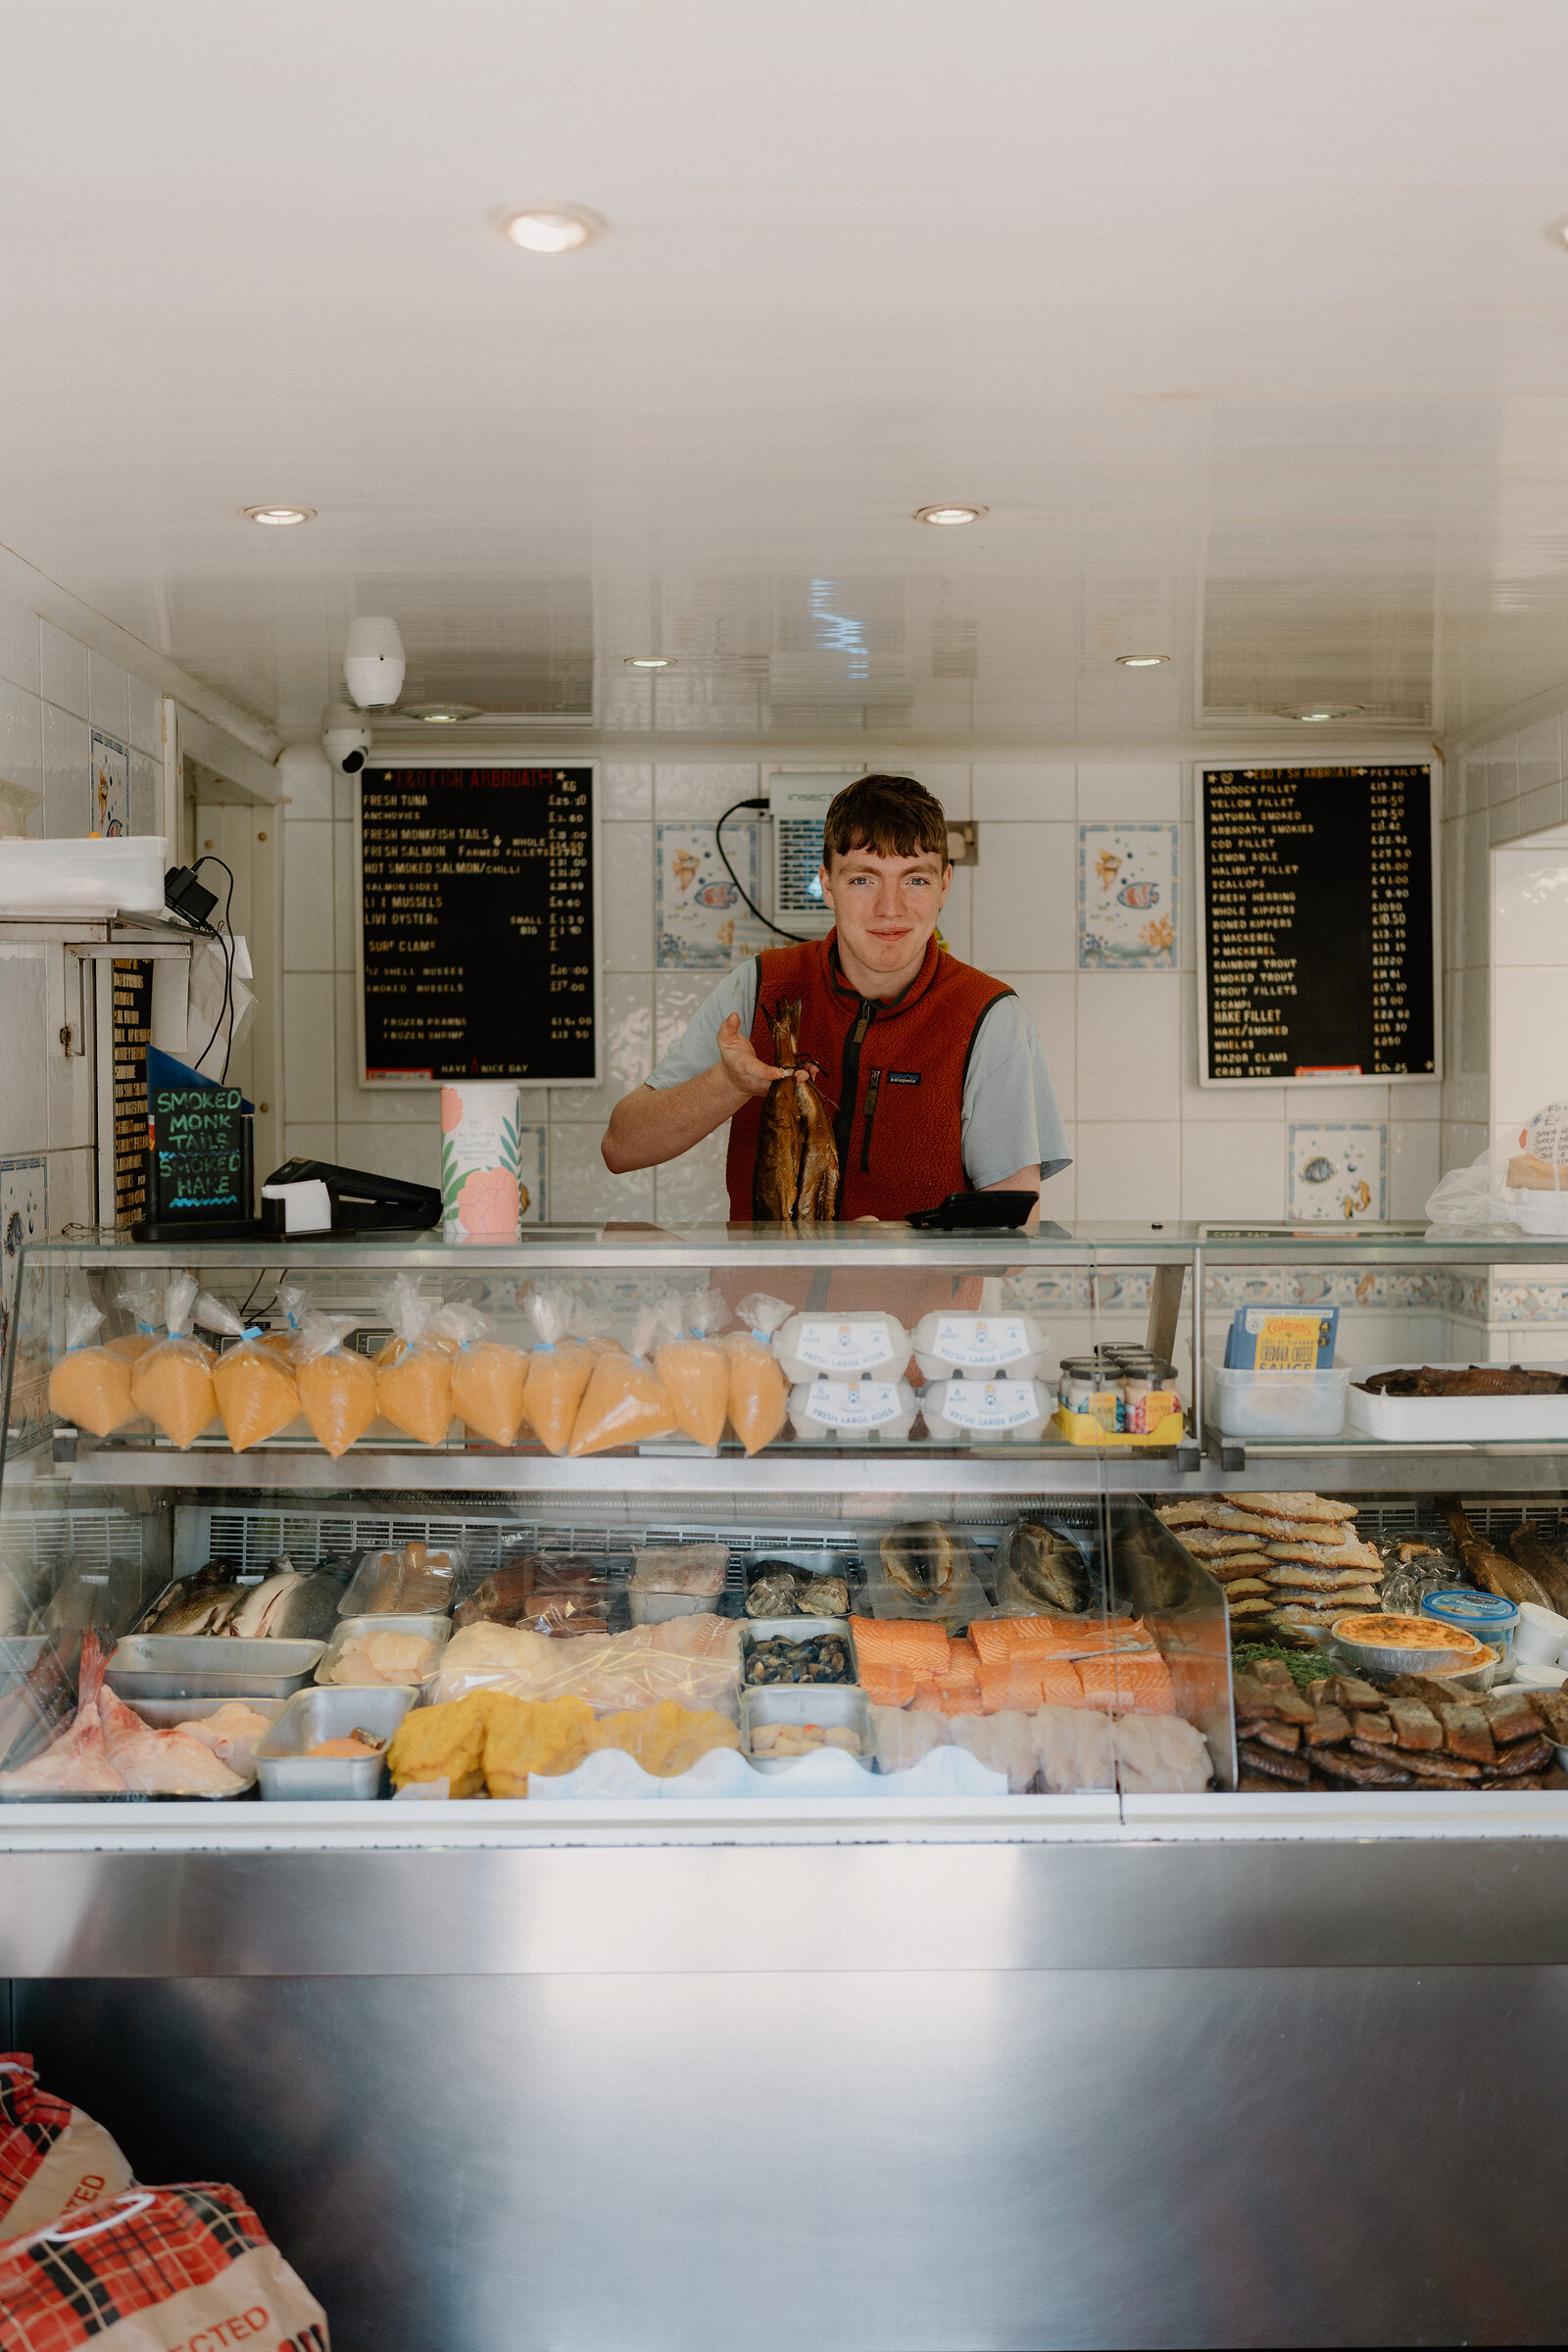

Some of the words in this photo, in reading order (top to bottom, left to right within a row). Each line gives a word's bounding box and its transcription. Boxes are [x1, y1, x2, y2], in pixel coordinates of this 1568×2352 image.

[471, 769, 553, 787] ARBROATH
[563, 781, 576, 792] KG
[1210, 785, 1257, 795] HADDOCK
[1260, 784, 1298, 794] FILLET
[364, 795, 398, 806] FRESH
[401, 795, 428, 806] TUNA
[1210, 799, 1251, 808] YELLOW
[1257, 798, 1294, 808] FILLET
[1210, 812, 1256, 822] NATURAL
[1261, 811, 1301, 820] SMOKED
[364, 829, 398, 840] FRESH
[401, 829, 456, 840] MONKFISH
[459, 829, 489, 840] TAILS
[1211, 825, 1265, 835] ARBROATH
[1271, 824, 1314, 833] SMOKIES
[1211, 840, 1233, 849] COD
[1238, 839, 1275, 849] FILLET
[364, 845, 398, 857] FRESH
[401, 845, 446, 857] SALMON
[458, 845, 500, 857] FARMED
[1211, 853, 1246, 862] LEMON
[1251, 852, 1278, 862] SOLE
[364, 862, 384, 873] HOT
[388, 862, 432, 874] SMOKED
[1211, 866, 1255, 876] HALIBUT
[1261, 864, 1298, 875] FILLET
[1212, 879, 1265, 889] SCALLOPS
[365, 897, 386, 907] LIE
[392, 897, 443, 907] MUSSELS
[1212, 893, 1247, 903] FRESH
[1251, 892, 1297, 902] HERRING
[1212, 906, 1247, 916] WHOLE
[1252, 905, 1296, 914] KIPPERS
[365, 913, 386, 924] LIVE
[1212, 920, 1248, 930] BONED
[1250, 918, 1293, 928] KIPPERS
[1222, 932, 1276, 943] MACKEREL
[1222, 946, 1276, 956] MACKEREL
[1213, 959, 1258, 970] RAINBOW
[1262, 958, 1298, 969] TROUT
[384, 967, 415, 976] SHELL
[1213, 973, 1254, 984] SMOKED
[1259, 972, 1294, 983] TROUT
[367, 984, 407, 993] SMOKED
[416, 984, 464, 993] MUSSELS
[1214, 986, 1248, 997] TROUT
[1253, 984, 1298, 996] FILLETS
[1214, 1000, 1251, 1009] SCAMPI
[383, 1017, 424, 1026] FROZEN
[427, 1017, 466, 1026] PRAWNS
[1214, 1011, 1242, 1023] HAKE
[1243, 1009, 1281, 1022] FILLET
[383, 1031, 424, 1040] FROZEN
[428, 1031, 464, 1040] SHRIMP
[1214, 1040, 1254, 1051] WHELKS
[1214, 1054, 1249, 1063] RAZOR
[1254, 1053, 1289, 1062] CLAMS
[441, 1064, 466, 1073] HAVE
[481, 1064, 504, 1073] NICE
[509, 1064, 528, 1073] DAY
[1214, 1066, 1243, 1077] CRAB
[1249, 1065, 1271, 1076] STIX
[158, 1090, 242, 1112] SMOKED
[170, 1113, 232, 1133] MONK
[169, 1131, 229, 1151] TAILS
[159, 1154, 241, 1177] SMOKED
[176, 1175, 230, 1197] HAKE
